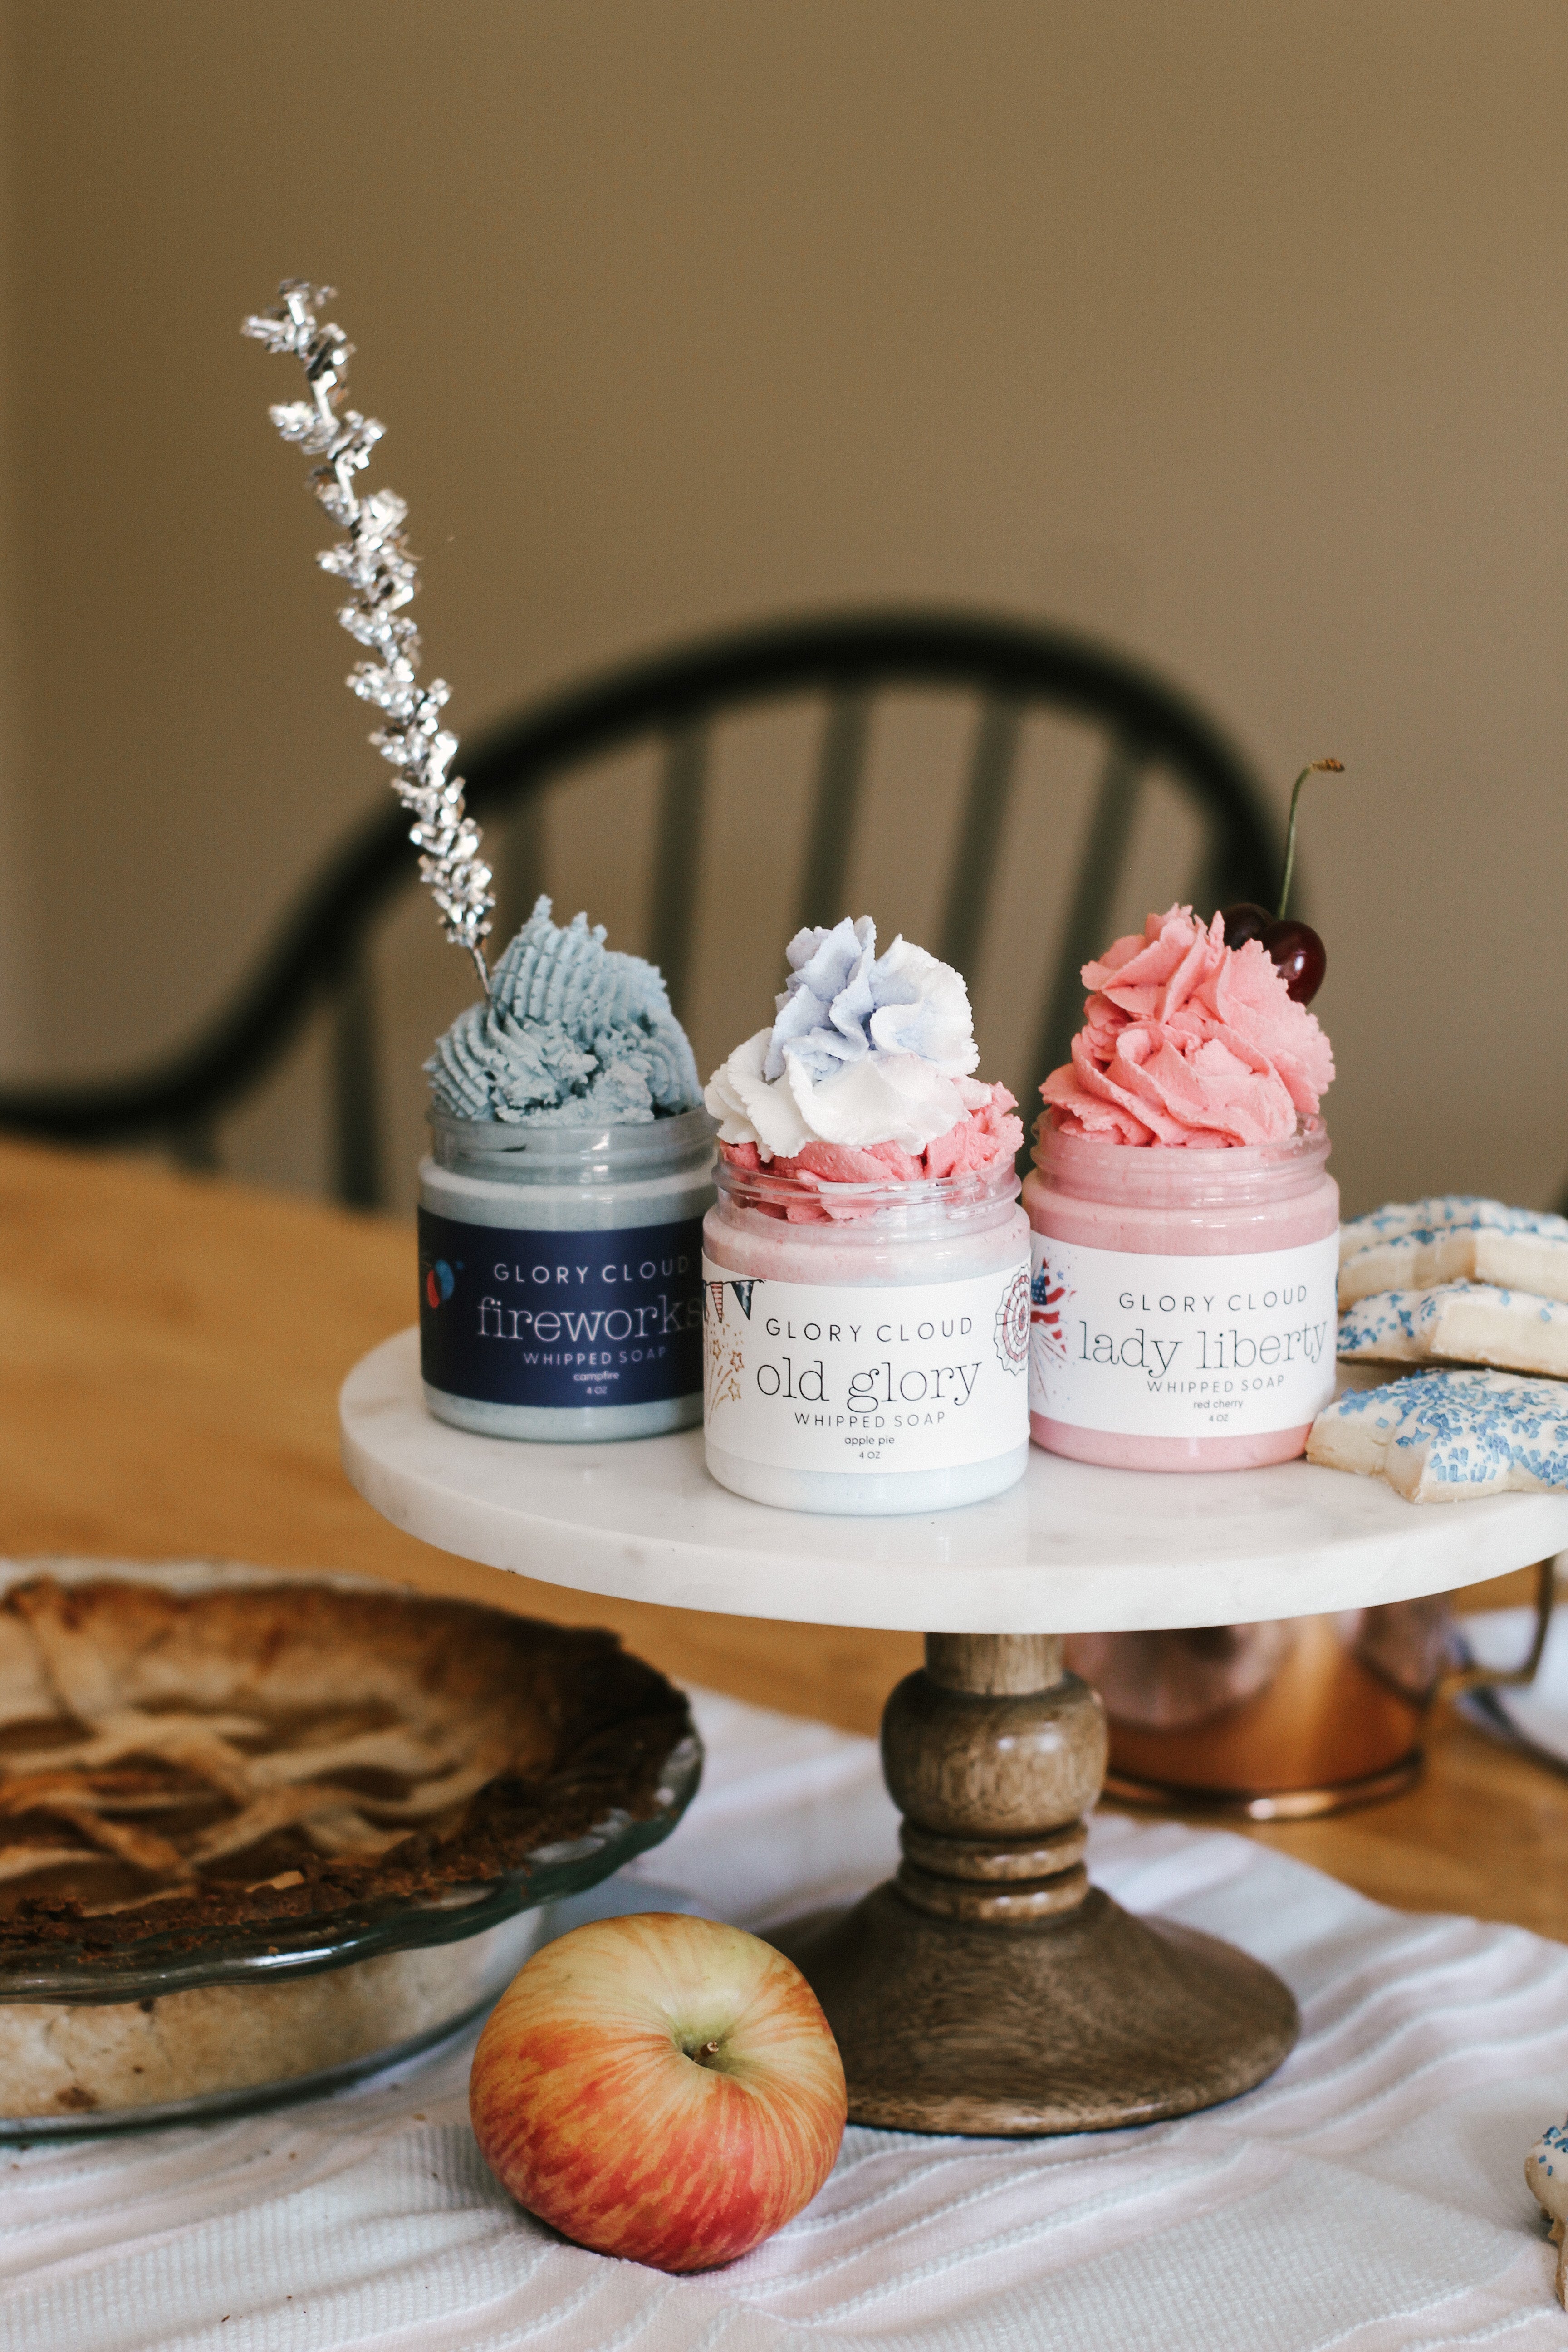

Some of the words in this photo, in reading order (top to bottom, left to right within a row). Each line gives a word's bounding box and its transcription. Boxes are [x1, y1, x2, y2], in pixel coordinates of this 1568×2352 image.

[494, 1263, 588, 1284] GLORY
[601, 1256, 688, 1283] CLOUD
[1119, 1293, 1215, 1312] GLORY
[1228, 1286, 1307, 1311] CLOUD
[477, 1295, 702, 1342] fireworks
[766, 1318, 862, 1342] GLORY
[877, 1318, 973, 1342] CLOUD
[524, 1352, 612, 1365] WHIPPED
[619, 1346, 667, 1363] SOAP
[1078, 1321, 1182, 1378] lady
[1196, 1321, 1328, 1369] liberty
[573, 1371, 619, 1382] campfire
[757, 1357, 829, 1401] old
[847, 1362, 982, 1413] glory
[1147, 1381, 1234, 1393] WHIPPED
[1241, 1375, 1284, 1391] SOAP
[1193, 1400, 1210, 1408] red
[1213, 1399, 1243, 1409] cherry
[795, 1412, 885, 1428] WHIPPED
[895, 1411, 945, 1427] SOAP
[844, 1436, 875, 1445] apple
[878, 1435, 895, 1445] pie
